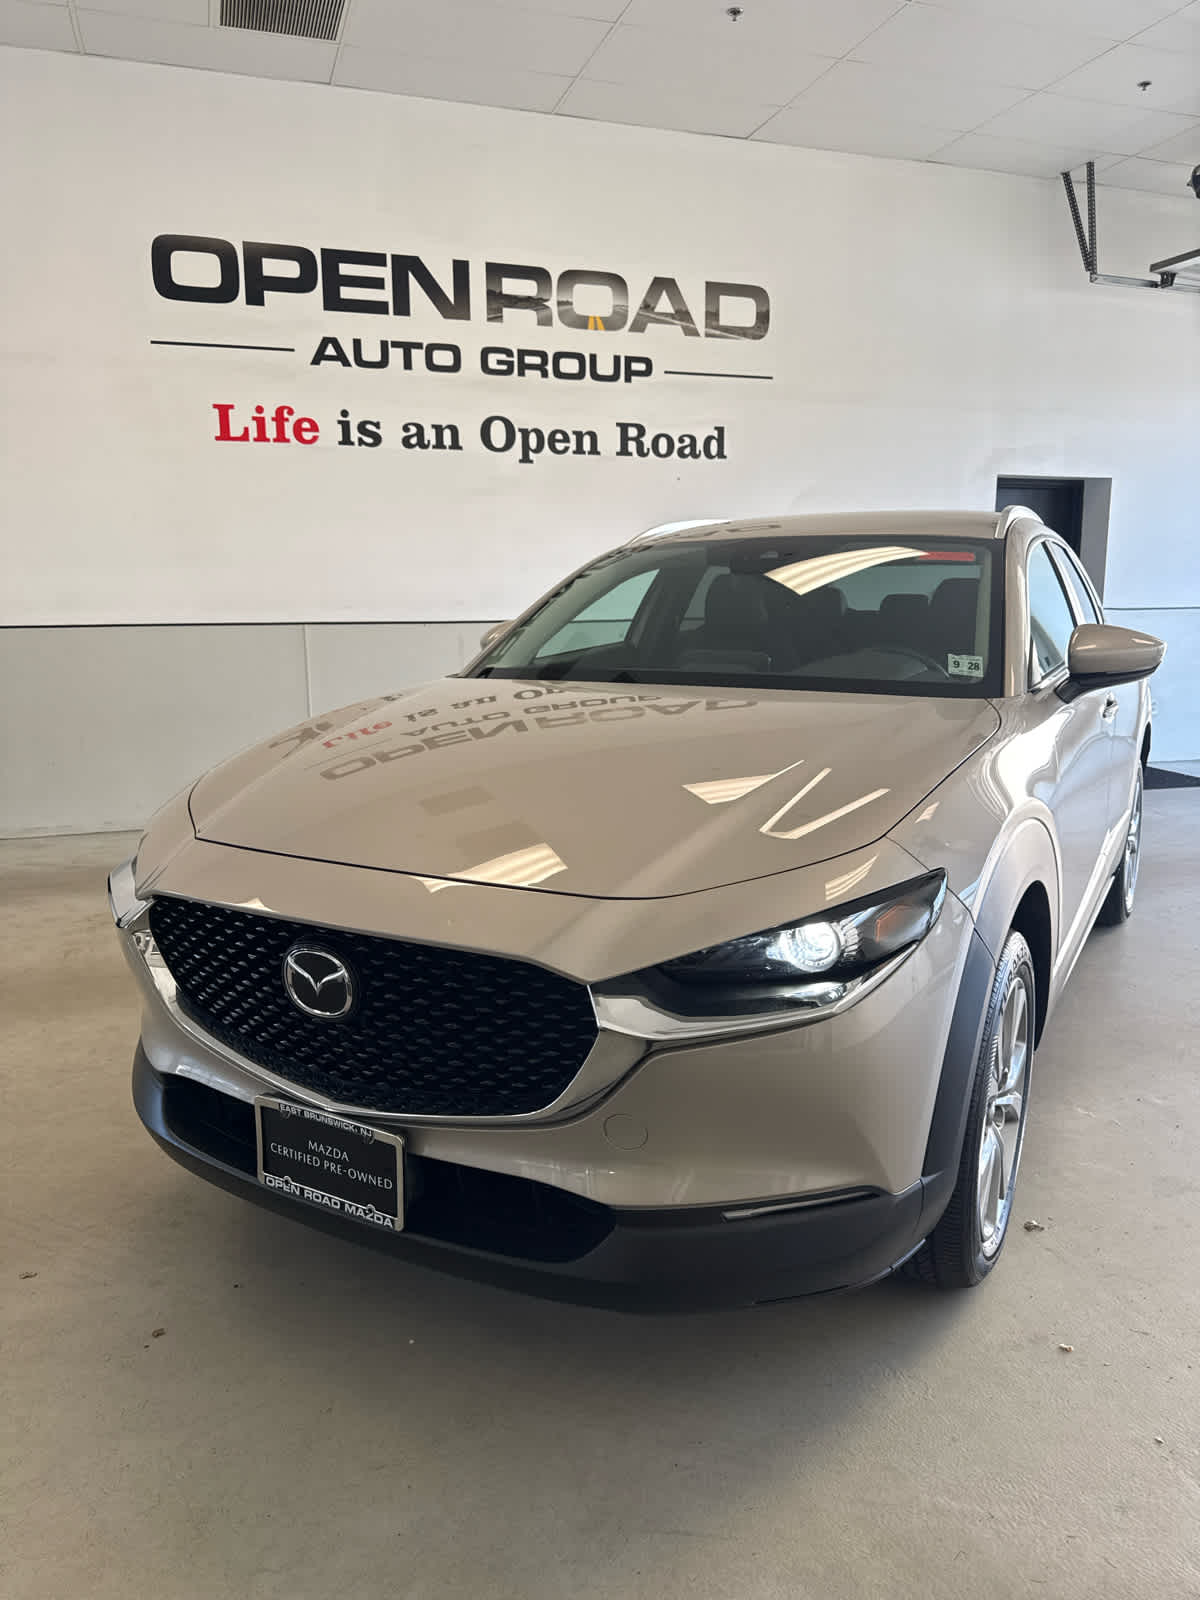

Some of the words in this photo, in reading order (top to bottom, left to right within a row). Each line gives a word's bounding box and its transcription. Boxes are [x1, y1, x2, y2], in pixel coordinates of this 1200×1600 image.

[151, 233, 471, 321] OPEN
[485, 262, 770, 340] ROAD
[310, 336, 461, 373] AUTO
[480, 346, 653, 383] GROUP
[212, 403, 320, 445] Life
[337, 409, 382, 447] is
[401, 421, 463, 450] an
[480, 415, 601, 464] Open
[615, 422, 727, 460] Road
[953, 660, 960, 668] 9
[967, 661, 980, 670] 28
[280, 1103, 302, 1117] EAST
[360, 1128, 372, 1137] NJ
[270, 1142, 321, 1167] CERTIFIED
[323, 1159, 393, 1190] PRE-OWNED
[308, 1140, 350, 1162] MAZDA
[265, 1176, 300, 1195] OPEN
[303, 1189, 341, 1209] ROAD
[344, 1203, 393, 1228] MAZDA
